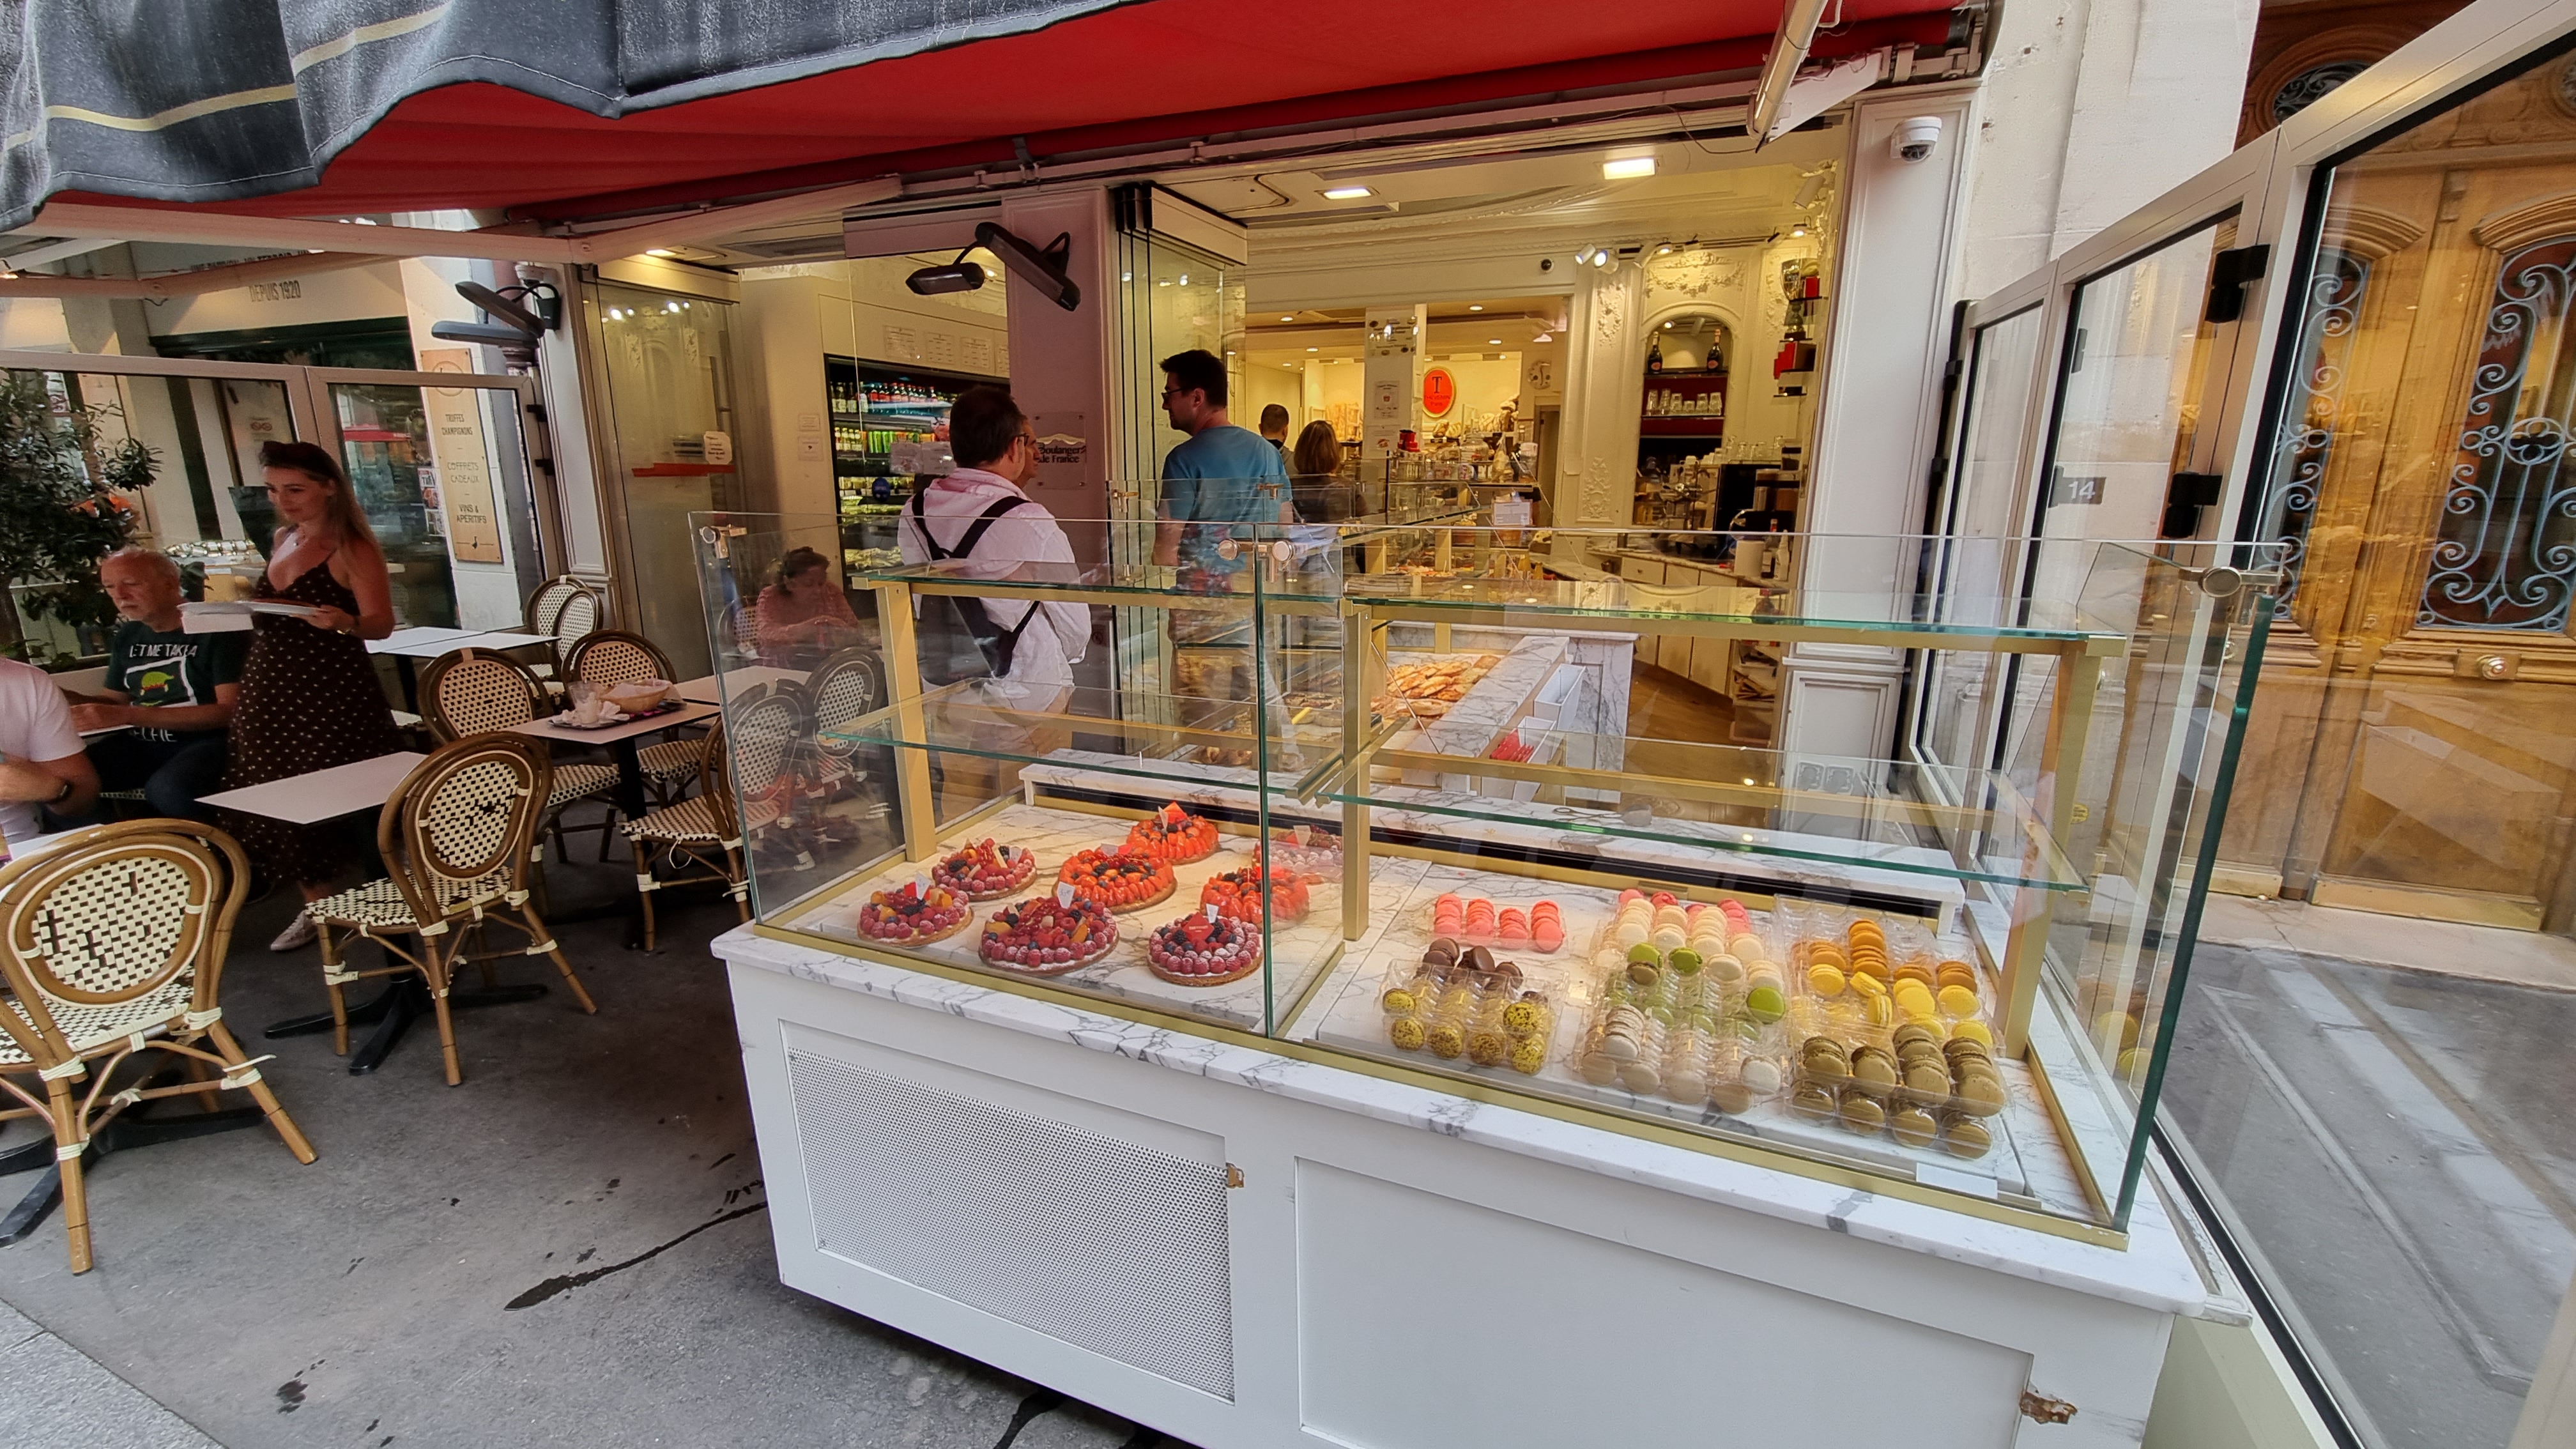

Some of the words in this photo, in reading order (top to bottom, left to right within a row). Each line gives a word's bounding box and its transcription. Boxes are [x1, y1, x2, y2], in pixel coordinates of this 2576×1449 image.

[249, 282, 279, 302] DEPUIS
[279, 280, 301, 299] 1920
[445, 414, 464, 422] TRUFFES
[441, 427, 473, 435] CHAMPIGNONS
[1052, 455, 1080, 463] France
[447, 461, 479, 471] COFFRETS
[450, 475, 479, 483] CADEAUX
[2068, 481, 2096, 499] 14
[458, 504, 473, 512] VINS
[456, 514, 487, 524] APERITIFS
[146, 644, 163, 657] ME
